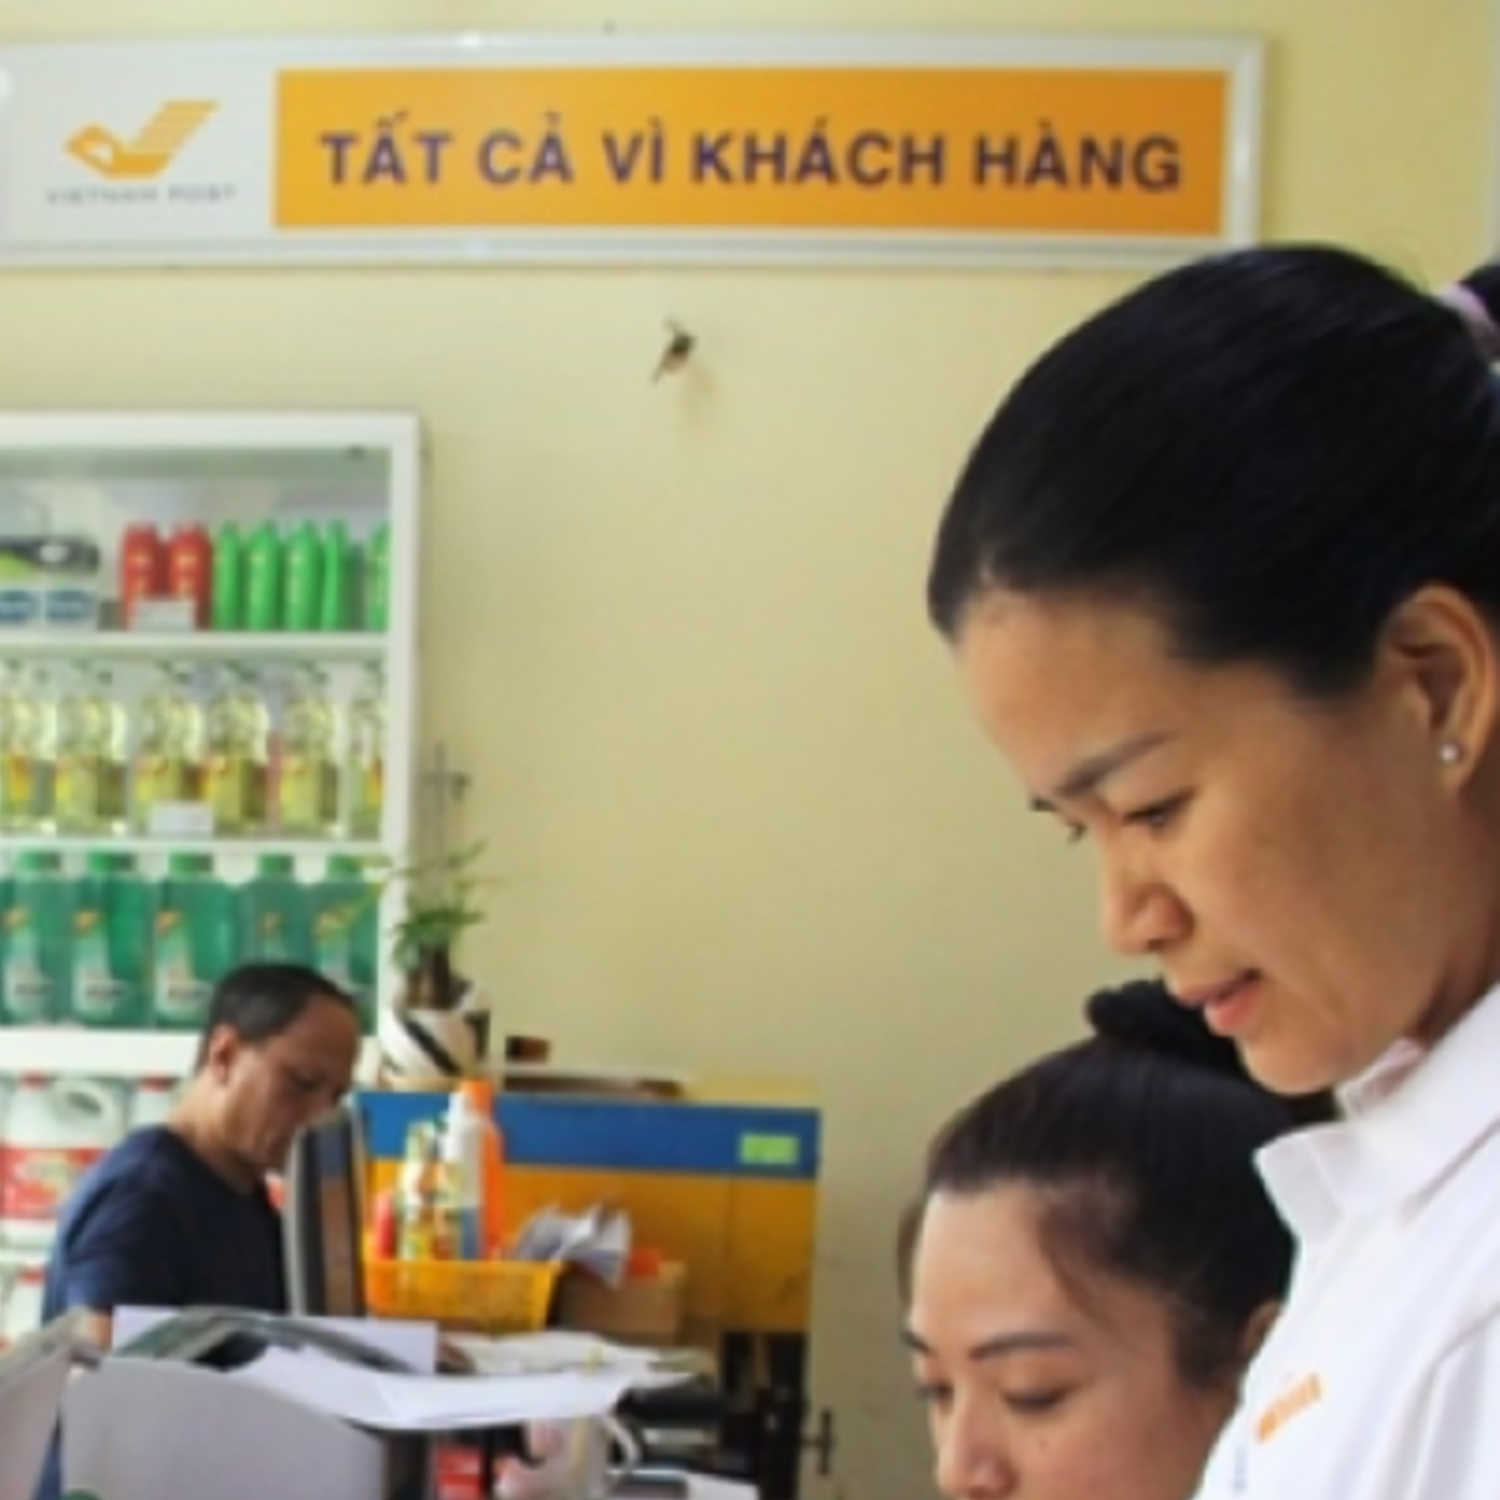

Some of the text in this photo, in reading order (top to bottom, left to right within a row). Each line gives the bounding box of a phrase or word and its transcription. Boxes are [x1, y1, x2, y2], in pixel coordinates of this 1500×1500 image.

[321, 110, 1181, 191] TẤT CẢ VÌ KHÁCH HÀNG
